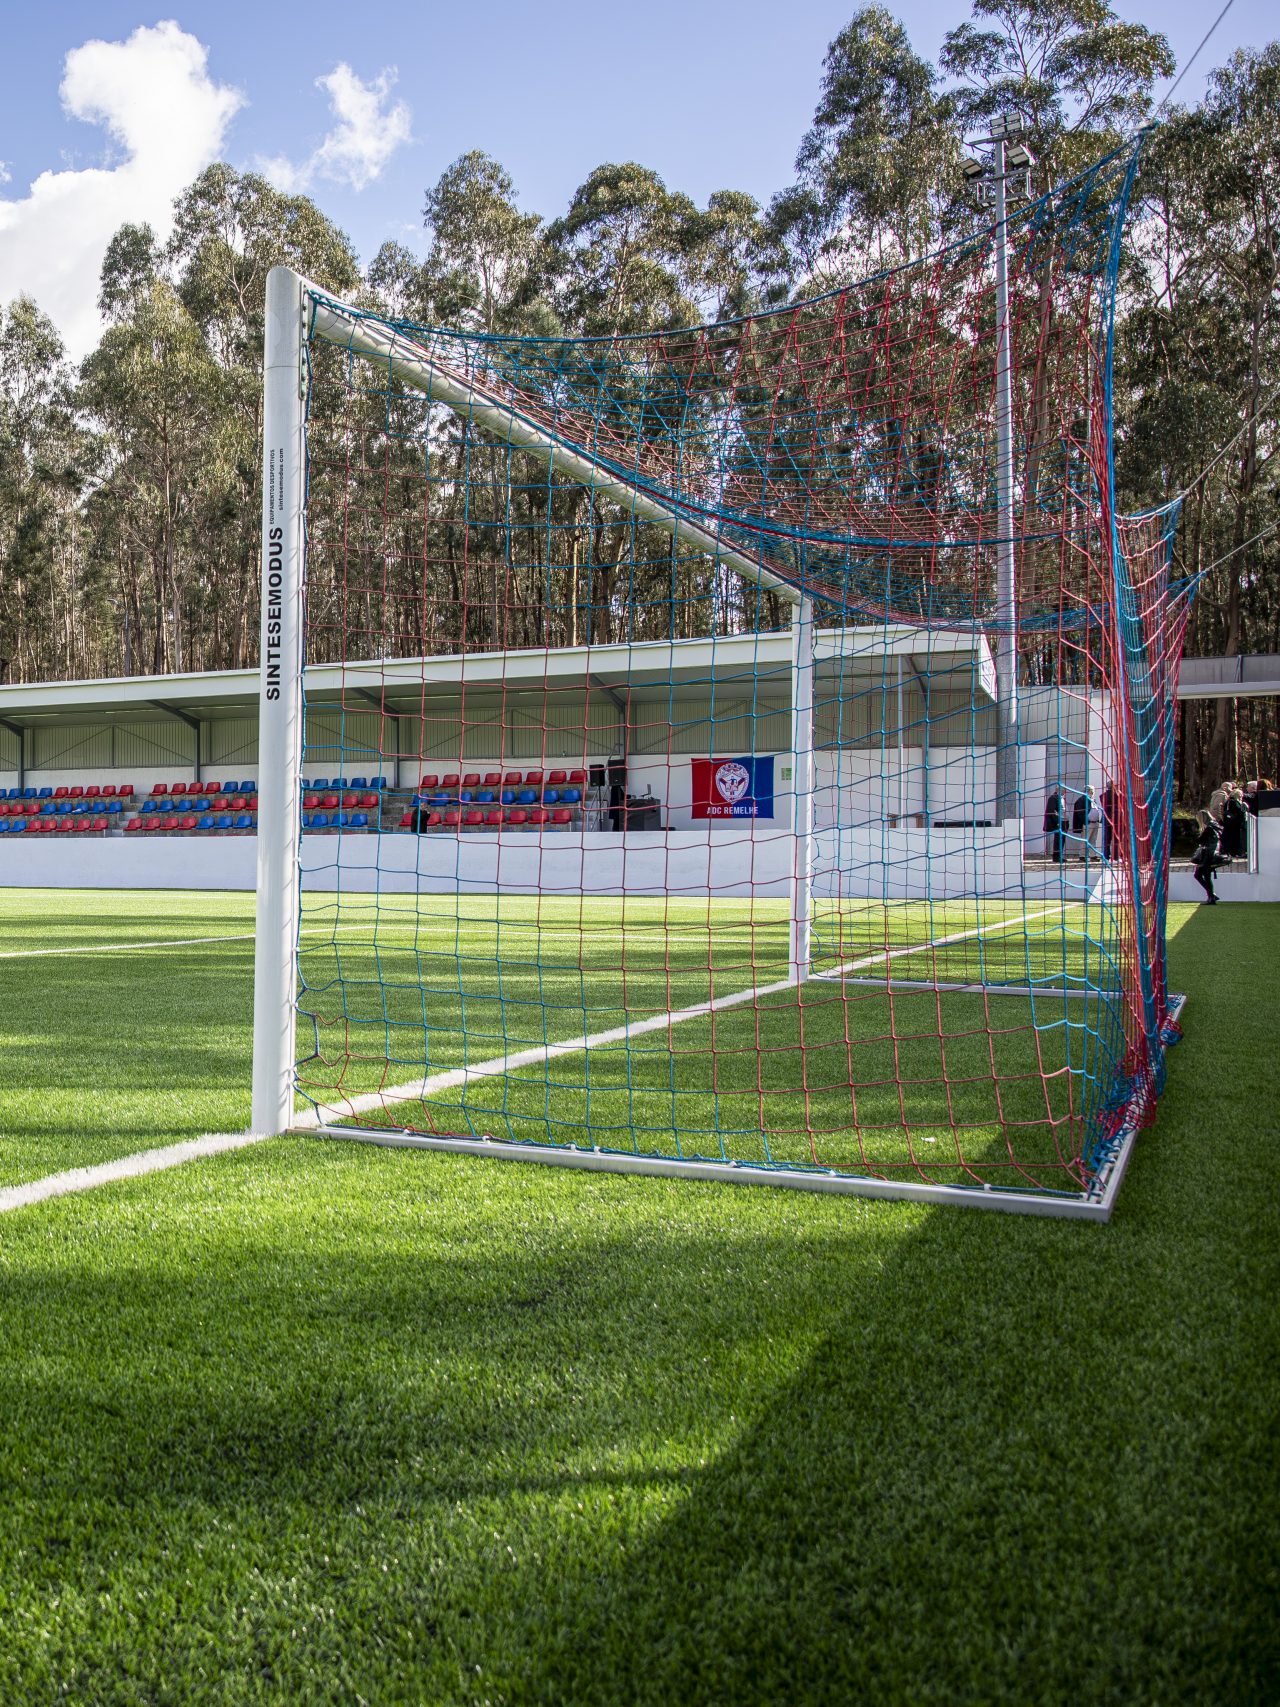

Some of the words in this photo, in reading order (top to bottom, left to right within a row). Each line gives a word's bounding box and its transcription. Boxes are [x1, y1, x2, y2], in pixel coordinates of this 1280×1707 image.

[266, 527, 283, 701] SINTESEMODUS
[706, 806, 722, 815] ADC
[723, 806, 759, 815] REMELHE
